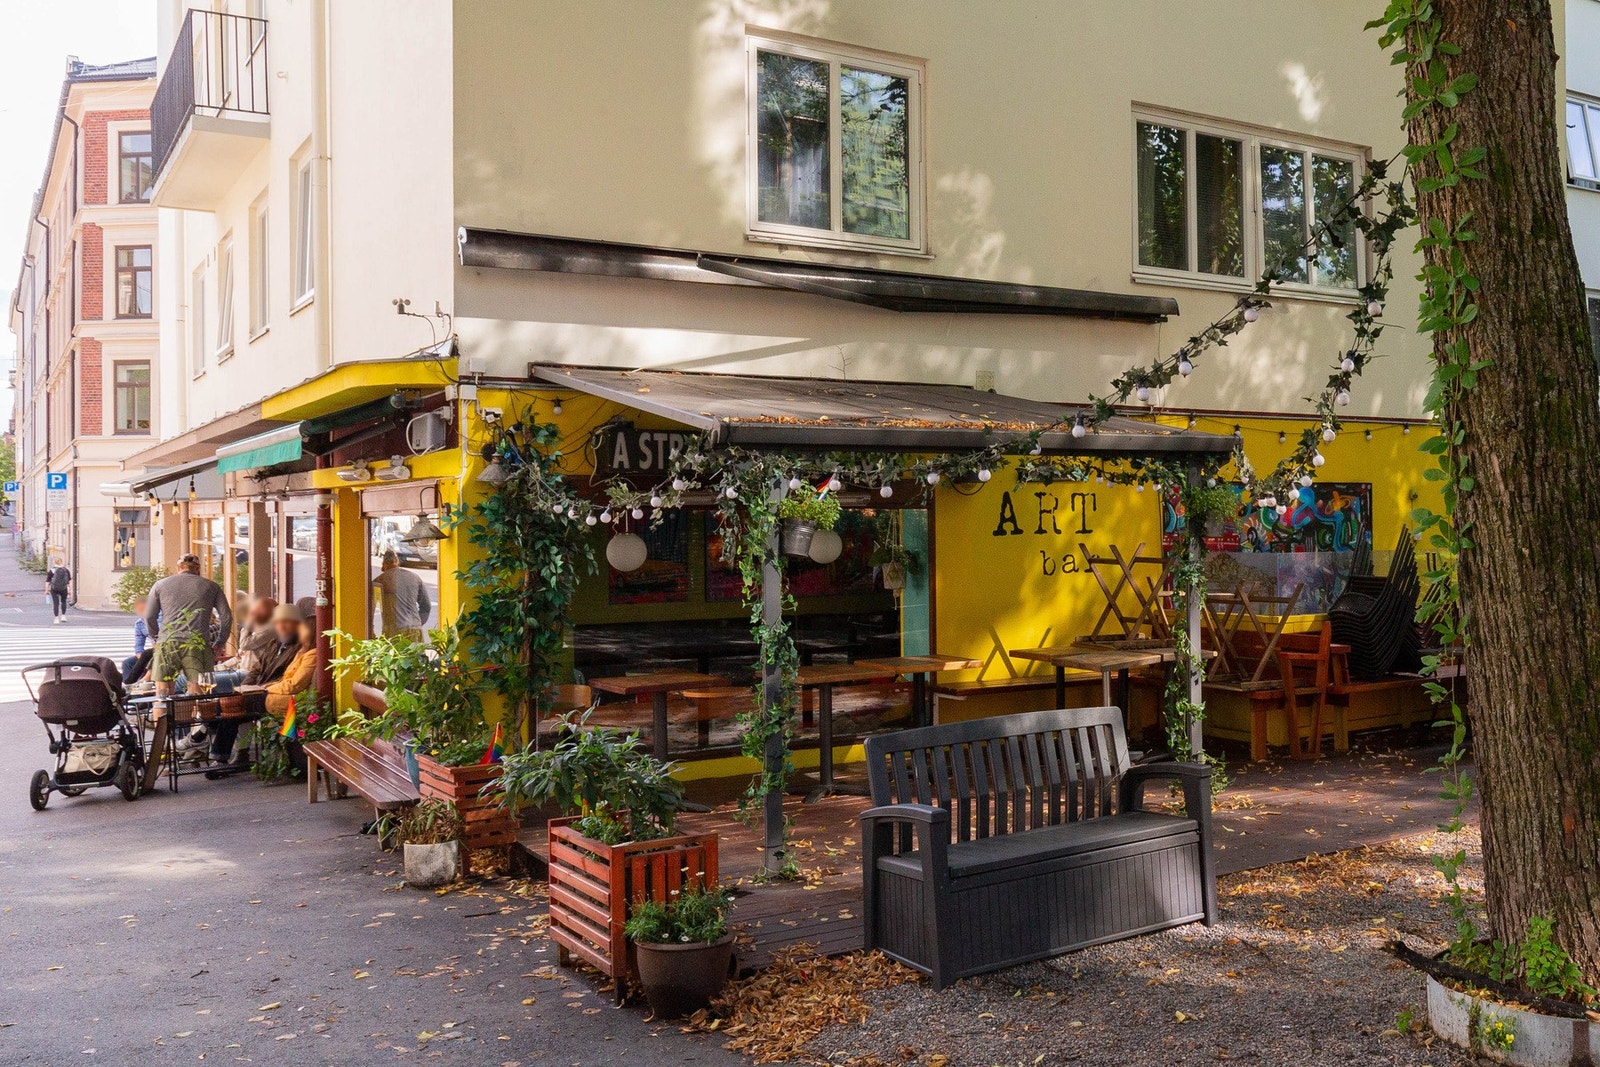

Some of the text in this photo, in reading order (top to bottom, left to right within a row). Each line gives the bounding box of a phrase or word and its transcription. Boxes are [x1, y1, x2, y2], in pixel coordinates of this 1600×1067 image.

[612, 431, 630, 469] A
[6, 483, 14, 491] P
[51, 474, 63, 488] P
[992, 491, 1097, 536] ART
